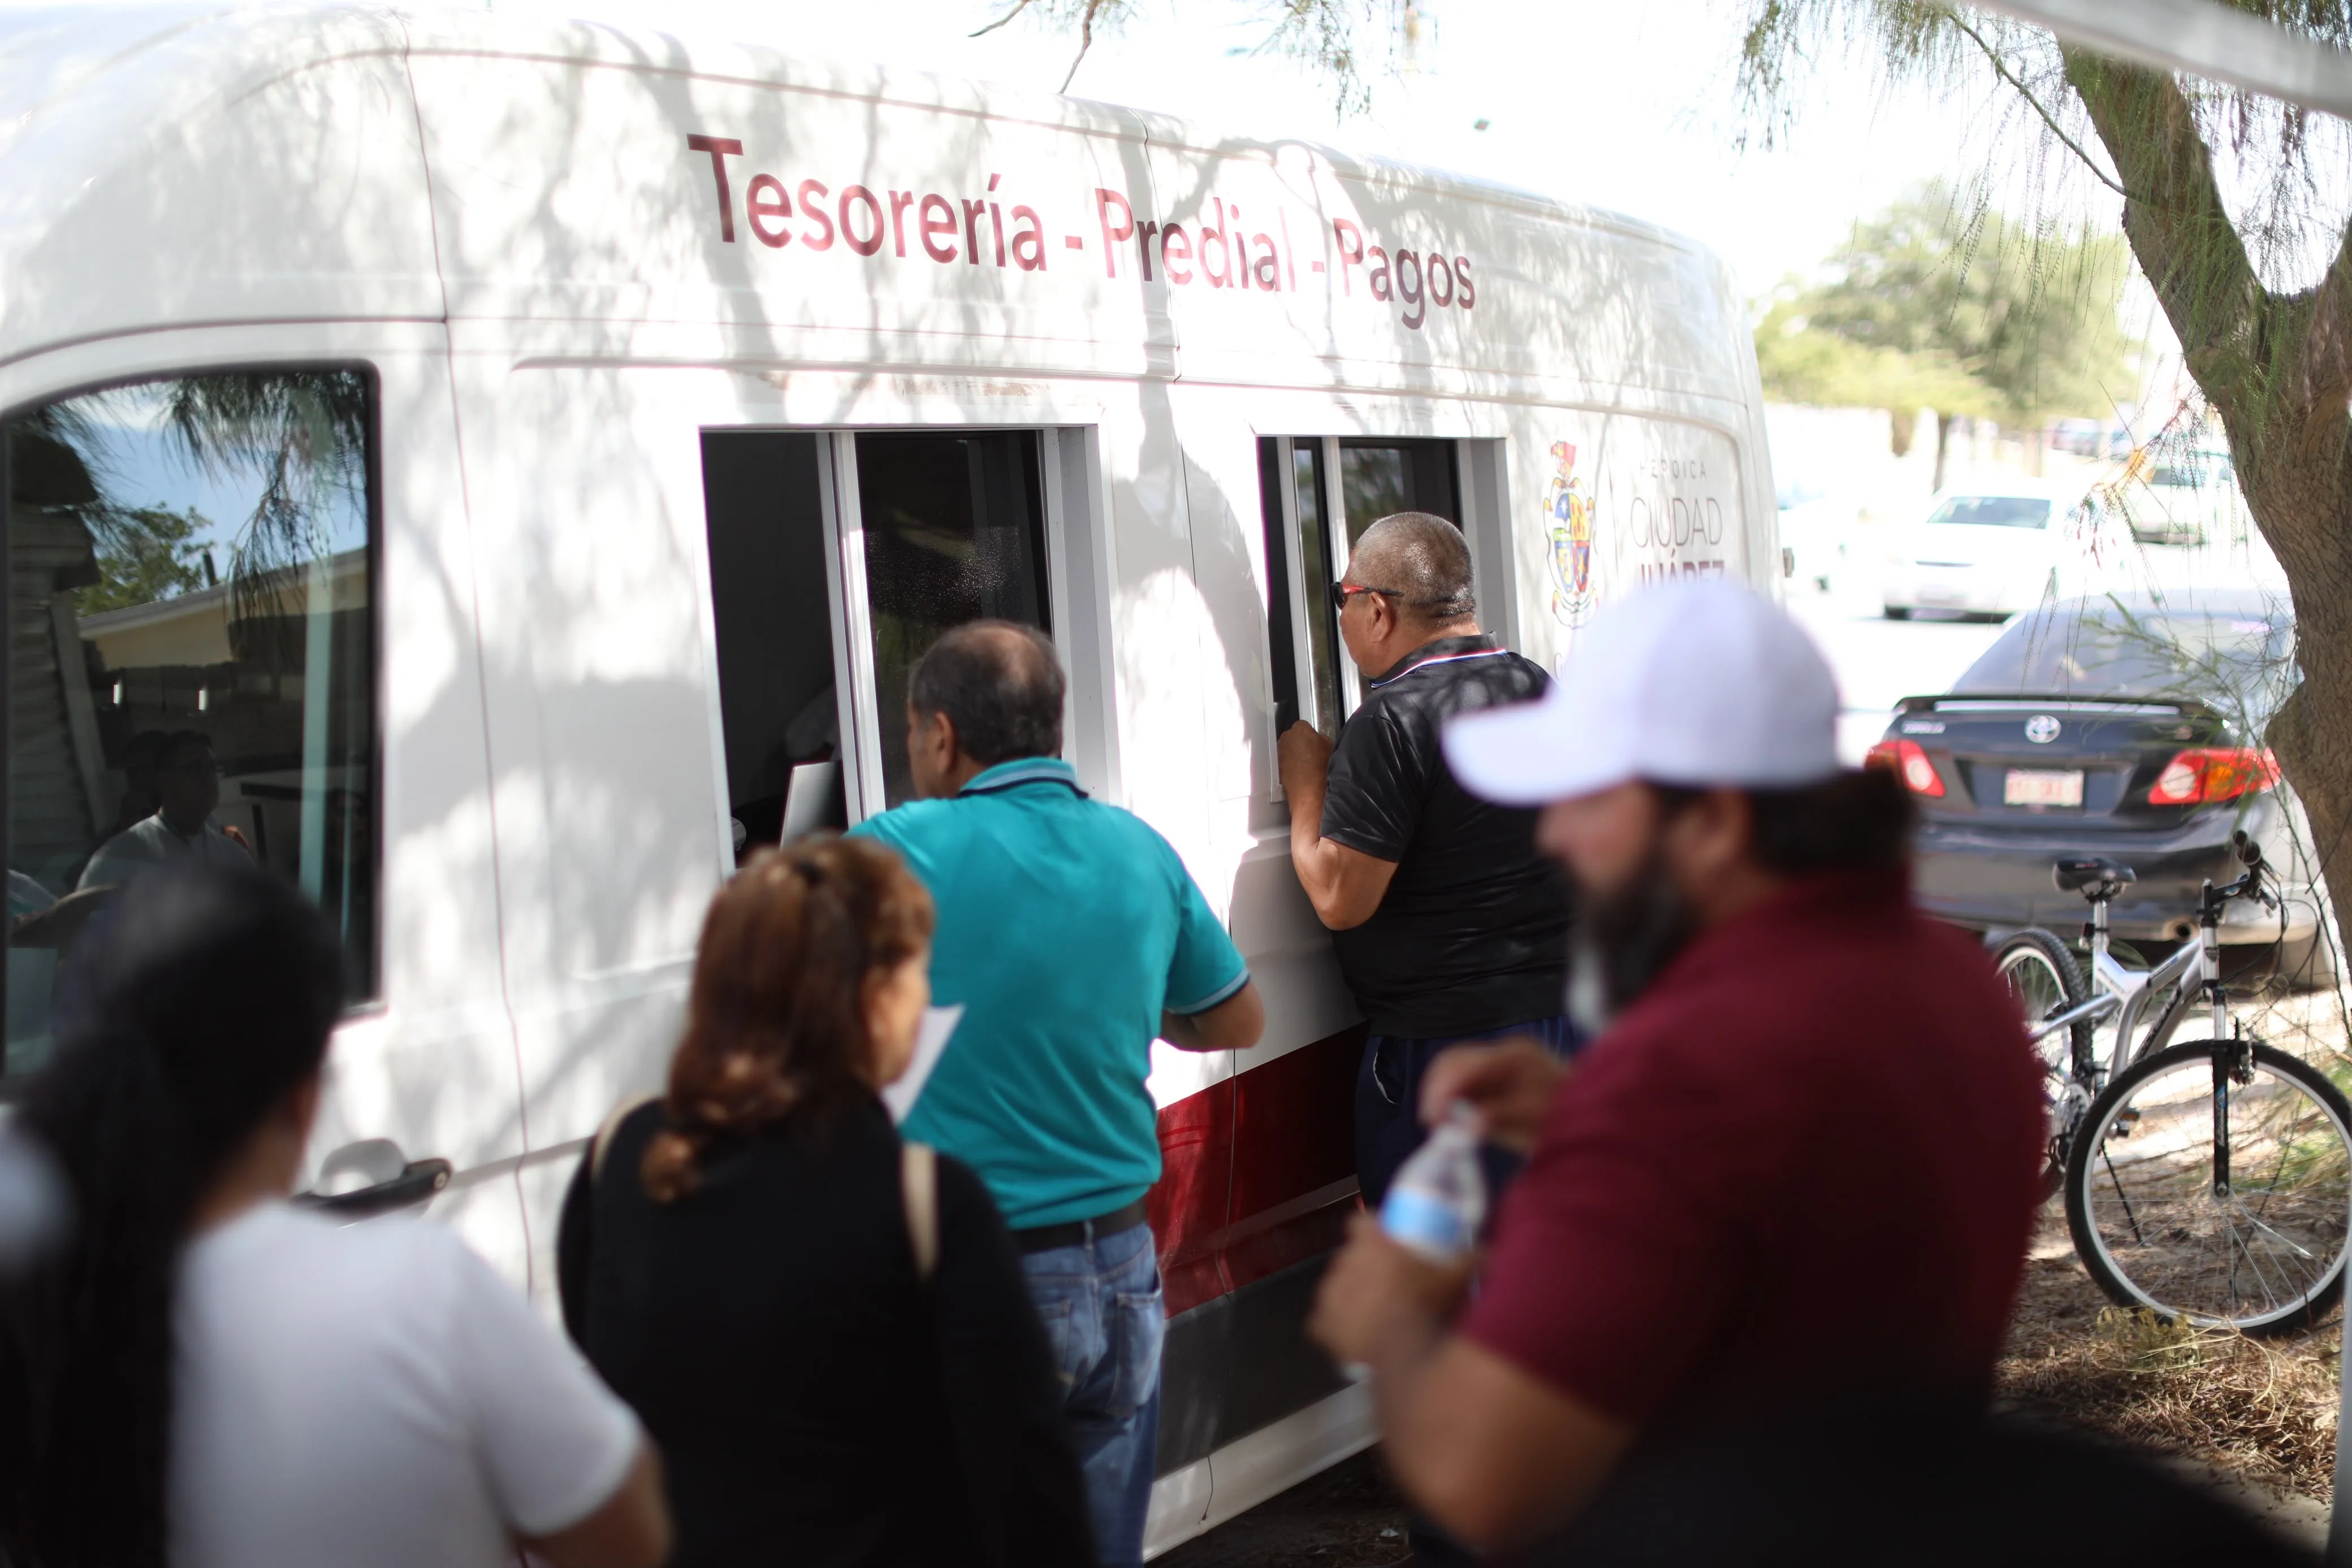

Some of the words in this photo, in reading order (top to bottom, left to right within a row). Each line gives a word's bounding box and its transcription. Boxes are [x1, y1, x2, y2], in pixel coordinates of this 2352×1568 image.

[686, 133, 1047, 271] Tesorería
[1065, 235, 1083, 250] -
[1095, 188, 1296, 292] Predial
[1311, 261, 1325, 273] -
[1332, 218, 1475, 330] Pagos
[1630, 497, 1723, 548] CIUDAD
